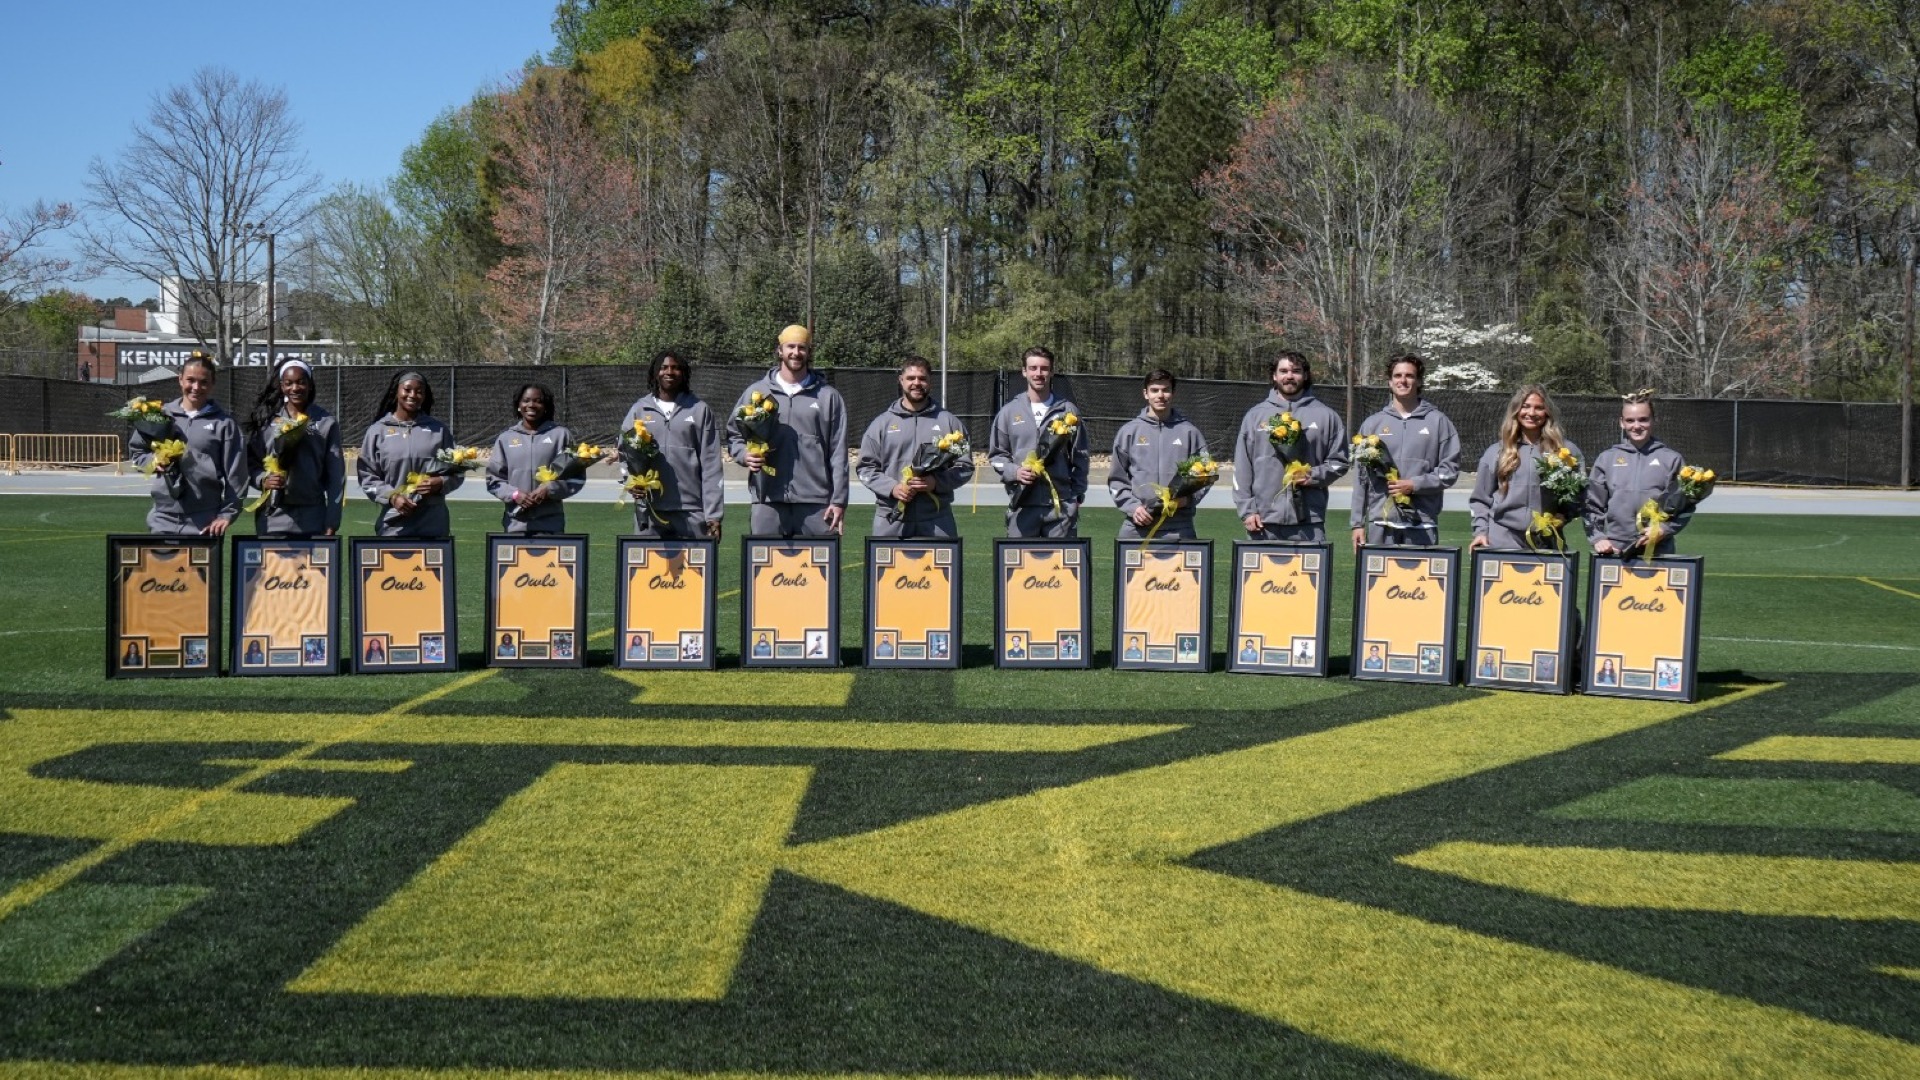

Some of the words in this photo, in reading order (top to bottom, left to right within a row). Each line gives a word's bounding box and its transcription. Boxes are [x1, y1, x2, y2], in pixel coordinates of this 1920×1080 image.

[140, 577, 189, 594] Owls
[264, 575, 310, 591] Owls
[381, 576, 426, 591] Owls
[514, 572, 559, 588] Owls
[649, 574, 686, 590] Owls
[772, 572, 808, 587] Owls
[895, 575, 931, 590] Owls
[1023, 575, 1062, 590] Owls
[1145, 576, 1181, 592] Owls
[1260, 580, 1298, 595] Owls
[1386, 585, 1428, 601] Owls
[1499, 589, 1545, 606] Owls
[1618, 595, 1666, 613] Owls
